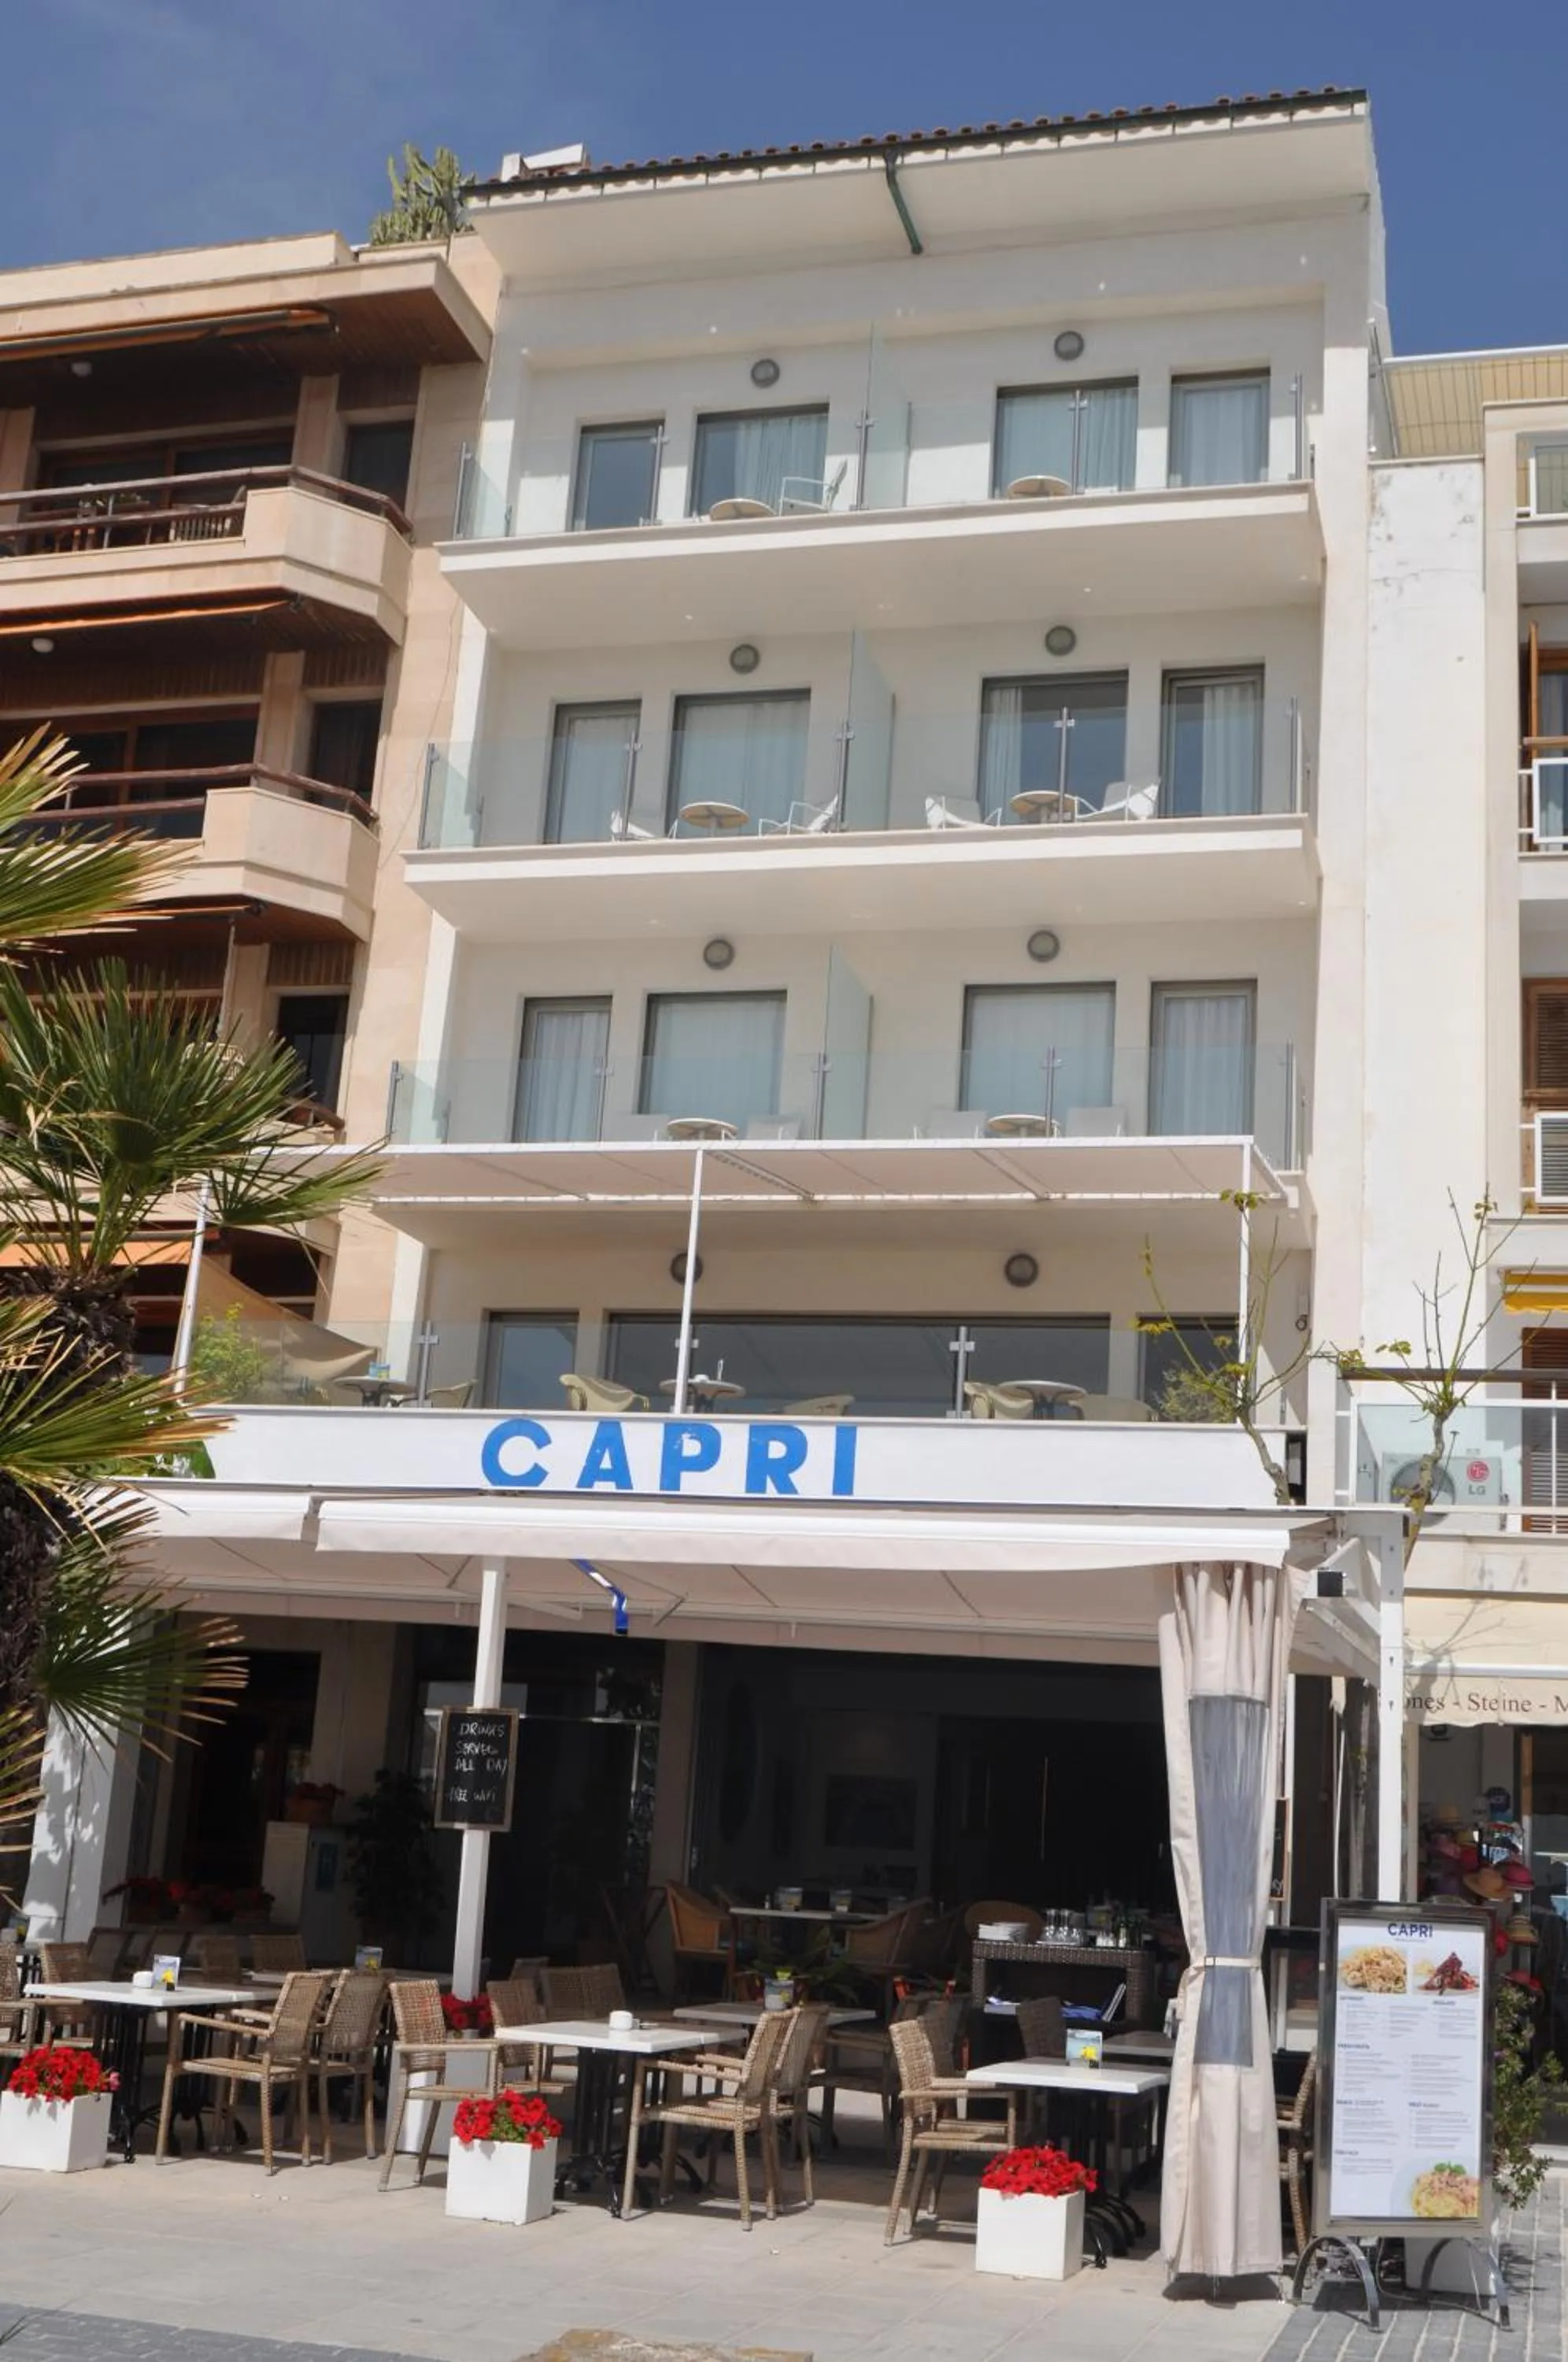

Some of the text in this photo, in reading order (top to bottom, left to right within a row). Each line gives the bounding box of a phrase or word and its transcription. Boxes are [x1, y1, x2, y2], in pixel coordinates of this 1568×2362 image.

[481, 1417, 857, 1496] CAPRI
[1468, 1484, 1486, 1496] LG
[1467, 1693, 1532, 1712] Steine
[1388, 1923, 1433, 1938] CAPRI
